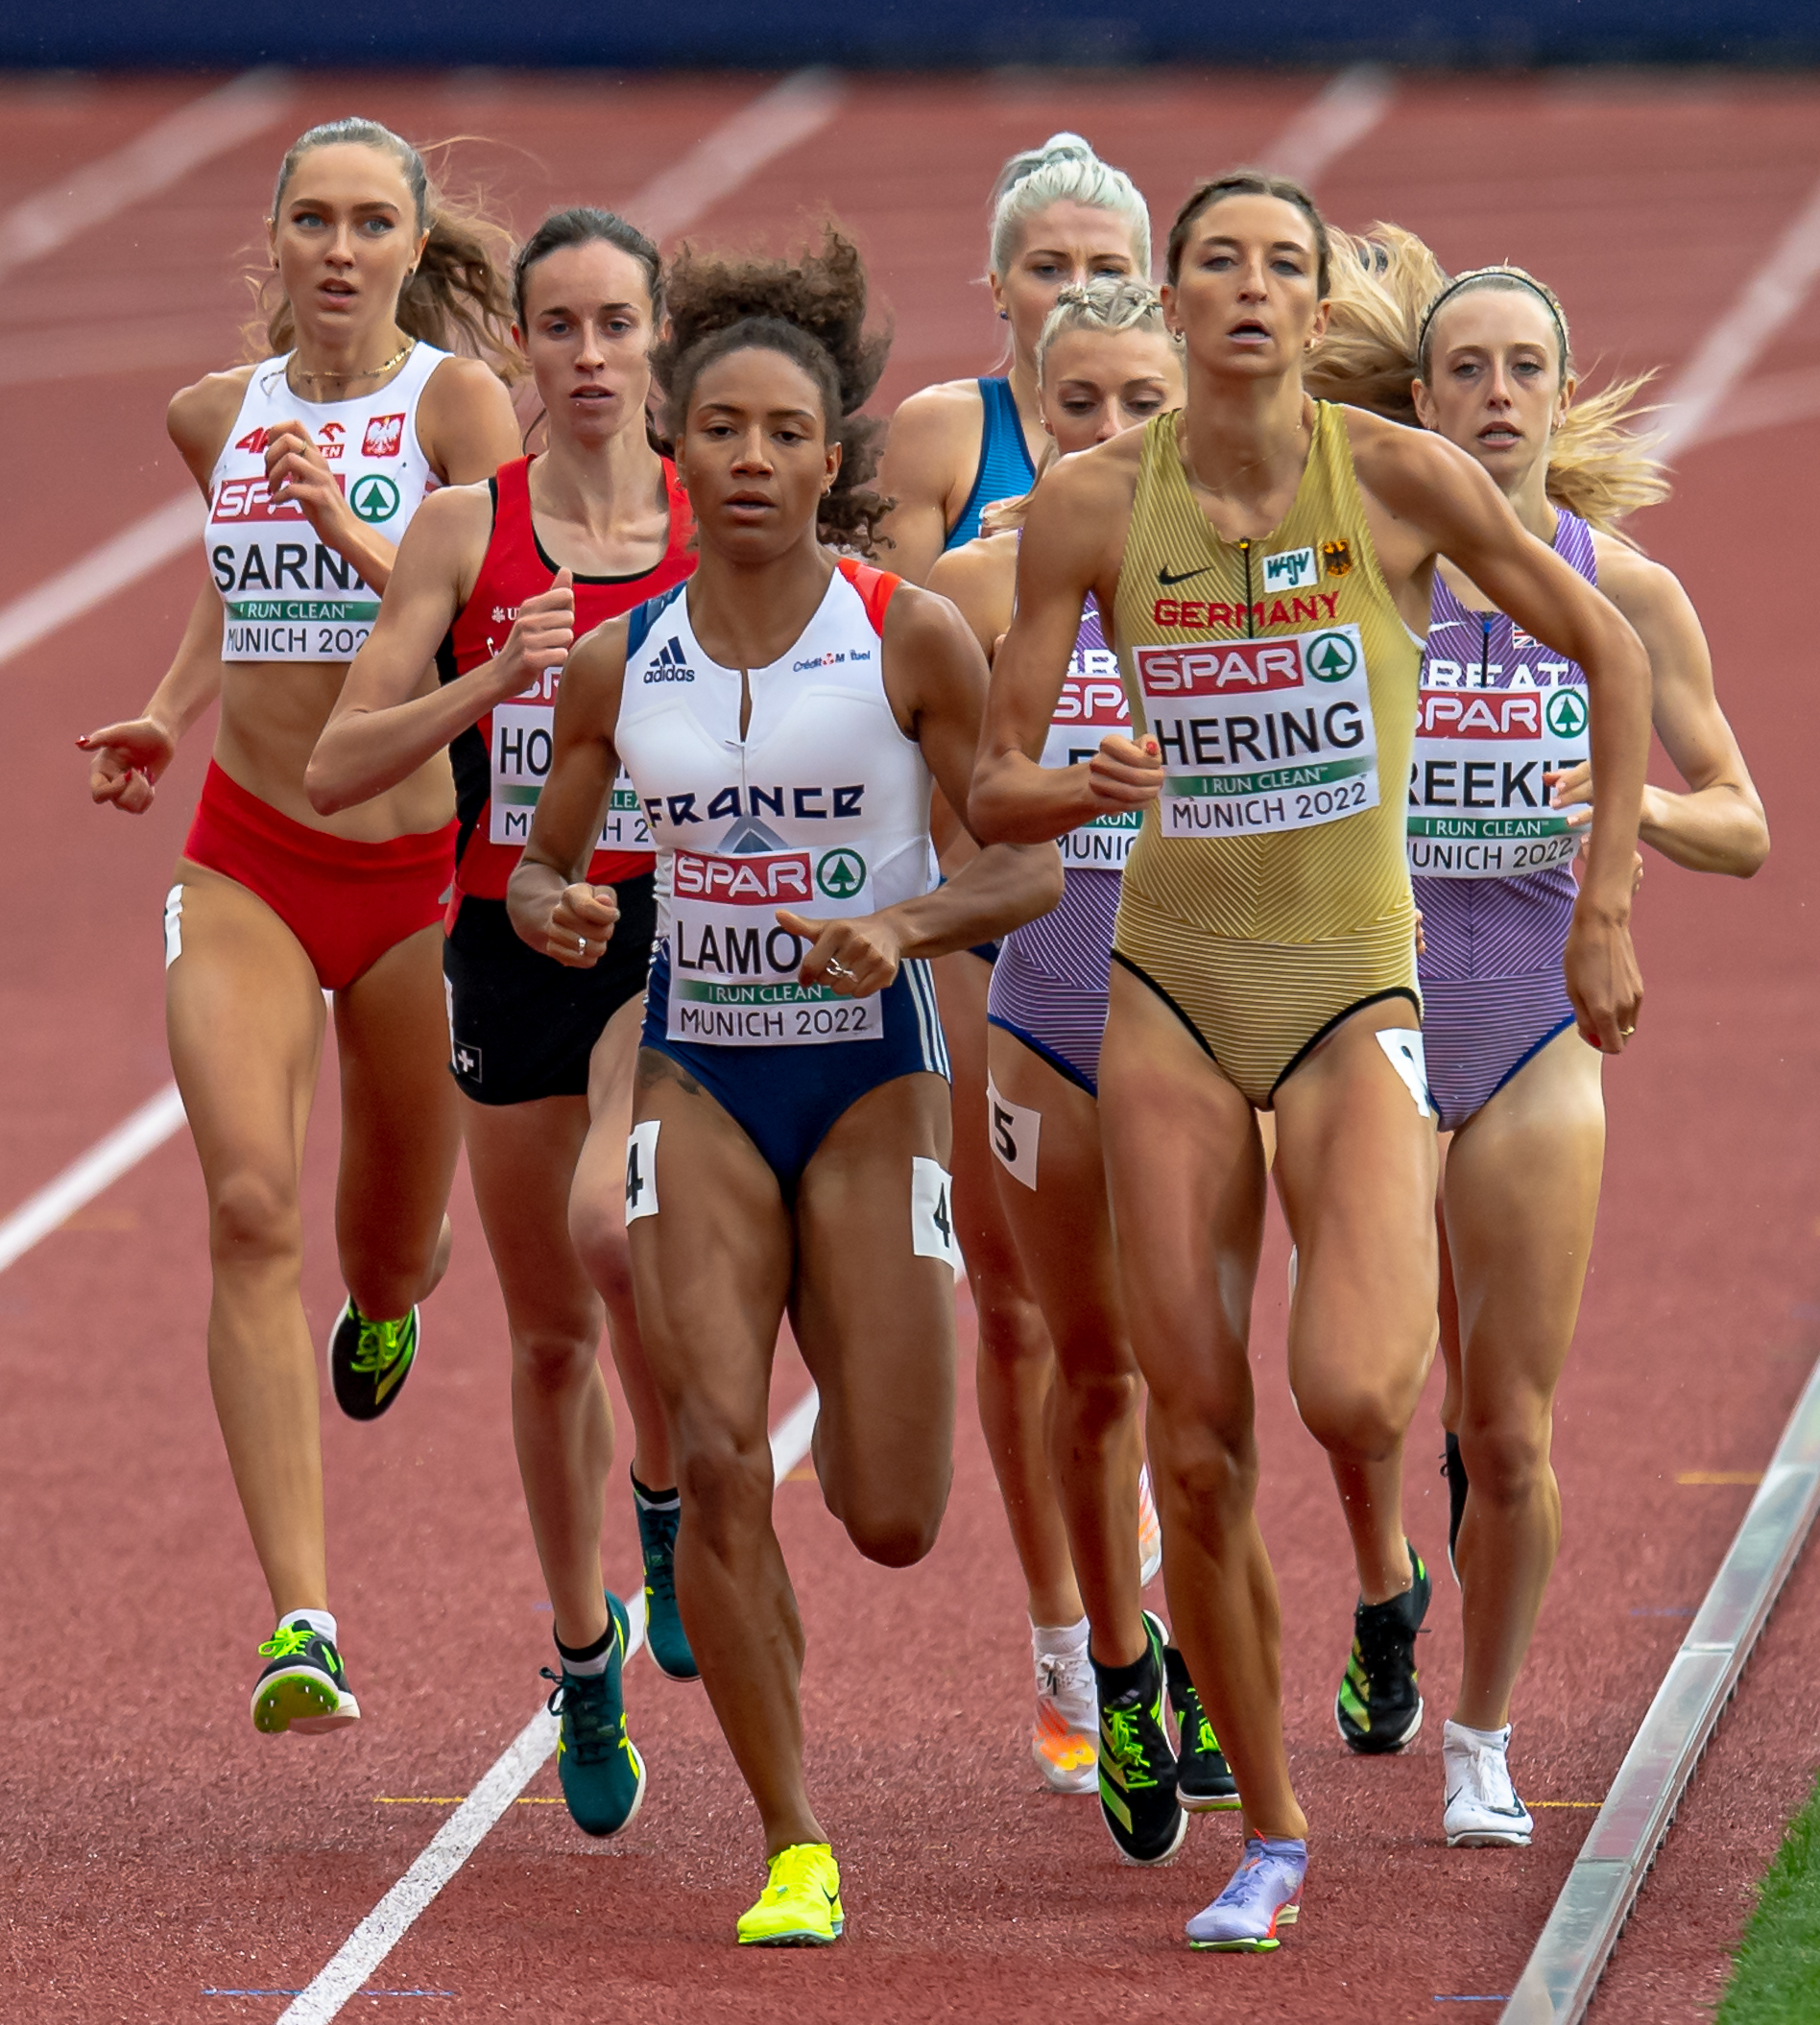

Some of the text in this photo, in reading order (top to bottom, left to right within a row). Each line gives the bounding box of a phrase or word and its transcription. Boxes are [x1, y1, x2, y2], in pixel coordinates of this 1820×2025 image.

[216, 481, 303, 517] SPA
[212, 544, 366, 592] SARN
[248, 603, 282, 618] RUN
[1154, 590, 1340, 628] GERMANY
[227, 628, 370, 653] MUNICH 202
[643, 666, 695, 683] adidas
[1145, 647, 1299, 690] SPAR
[1421, 659, 1569, 688] REAT
[1154, 701, 1365, 766] HERING
[1416, 698, 1538, 733] PAR
[1202, 767, 1322, 793] I RUN CLEAN
[644, 785, 865, 828] FRANCE
[1172, 781, 1367, 829] MUNICH 2022
[1425, 821, 1542, 837] I RUN CLEAN
[1412, 837, 1574, 870] UNICH 2022
[678, 856, 808, 897] SPAR
[677, 919, 803, 974] LAMO
[708, 985, 823, 1003] I RUN CLEAN
[681, 1006, 868, 1037] MUNICH 2022
[993, 1101, 1018, 1163] 5
[933, 1181, 950, 1249] 4
